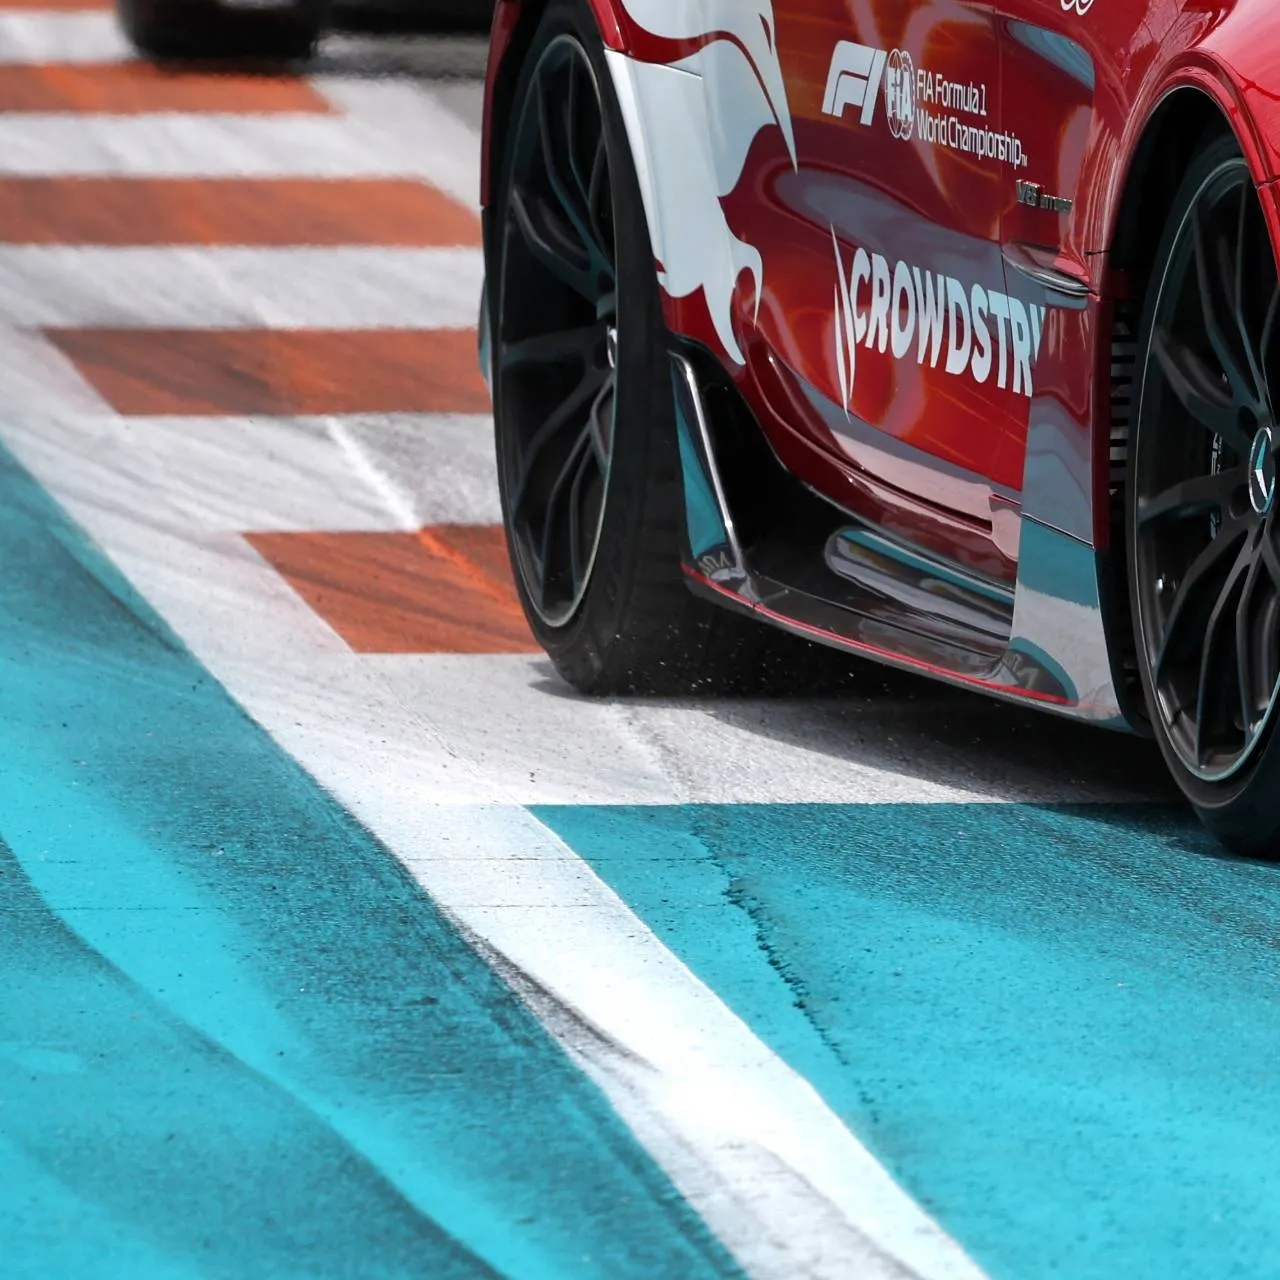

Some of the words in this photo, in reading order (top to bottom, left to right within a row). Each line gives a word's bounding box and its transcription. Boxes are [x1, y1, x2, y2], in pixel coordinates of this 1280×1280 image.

[821, 39, 887, 127] F1
[886, 66, 913, 121] FIA
[916, 69, 934, 102] FIA
[935, 72, 979, 113] Formula
[979, 83, 987, 117] 1
[916, 108, 947, 146] World
[948, 117, 1022, 169] Championship
